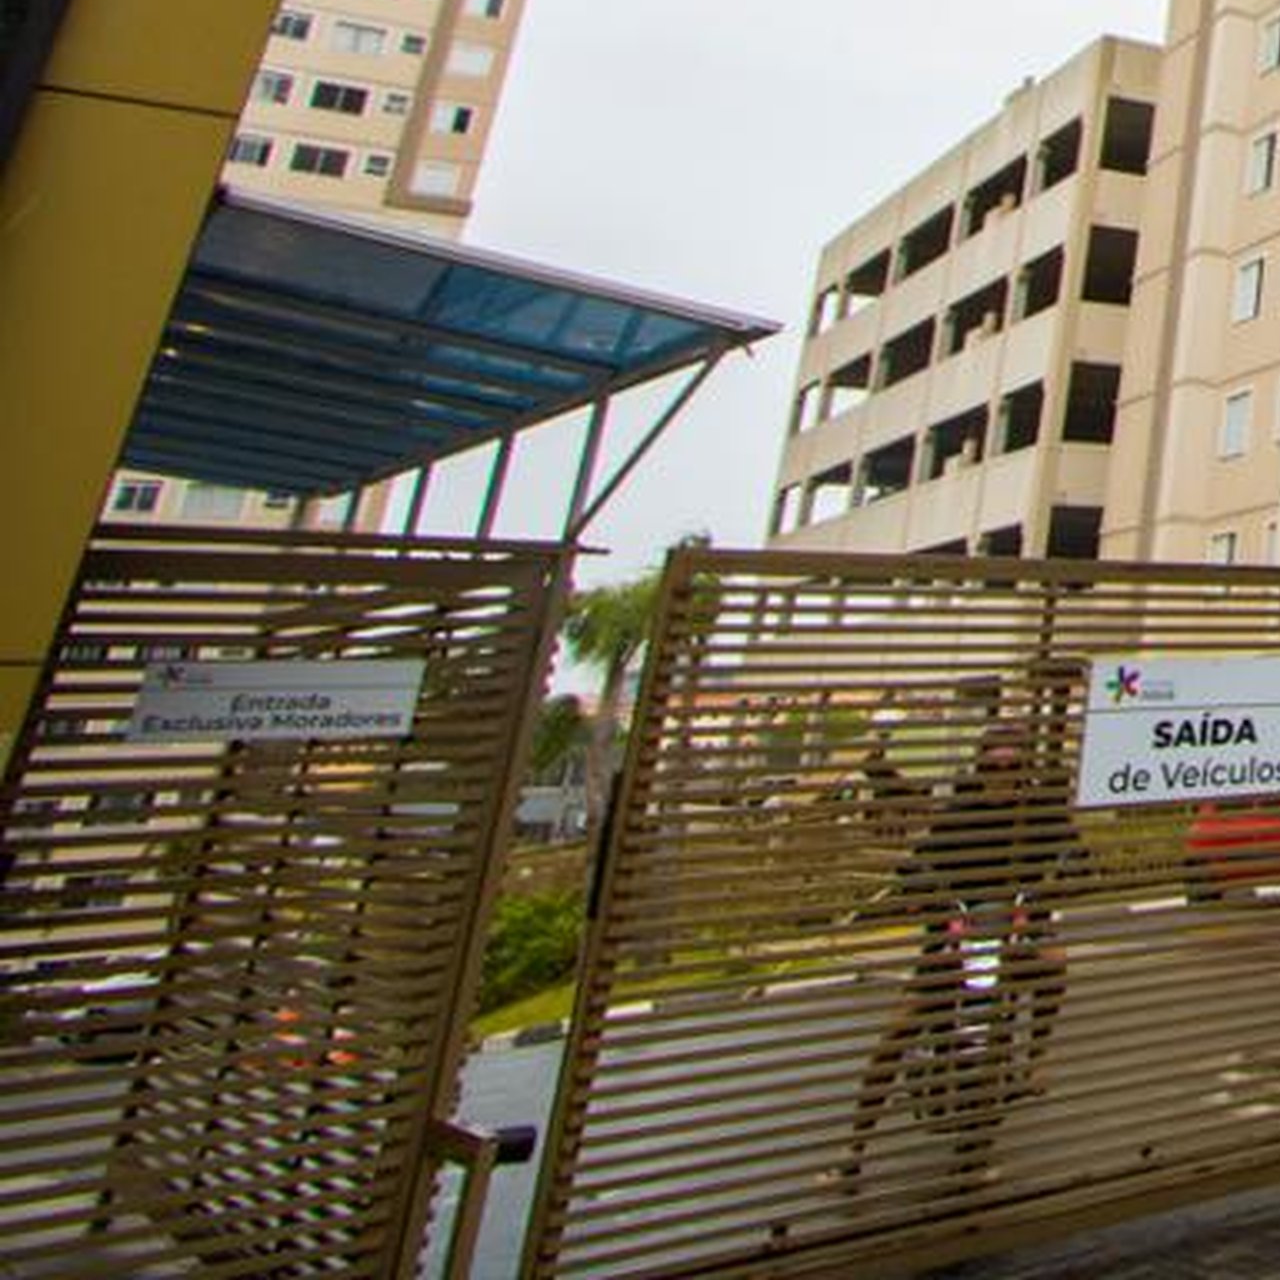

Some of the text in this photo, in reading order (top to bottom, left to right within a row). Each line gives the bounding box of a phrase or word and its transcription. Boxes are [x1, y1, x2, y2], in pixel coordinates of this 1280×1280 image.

[230, 692, 331, 713] Entrada
[141, 712, 402, 733] Exclusiva Moradores
[1154, 711, 1258, 749] SAÍDA
[1109, 762, 1150, 795] de
